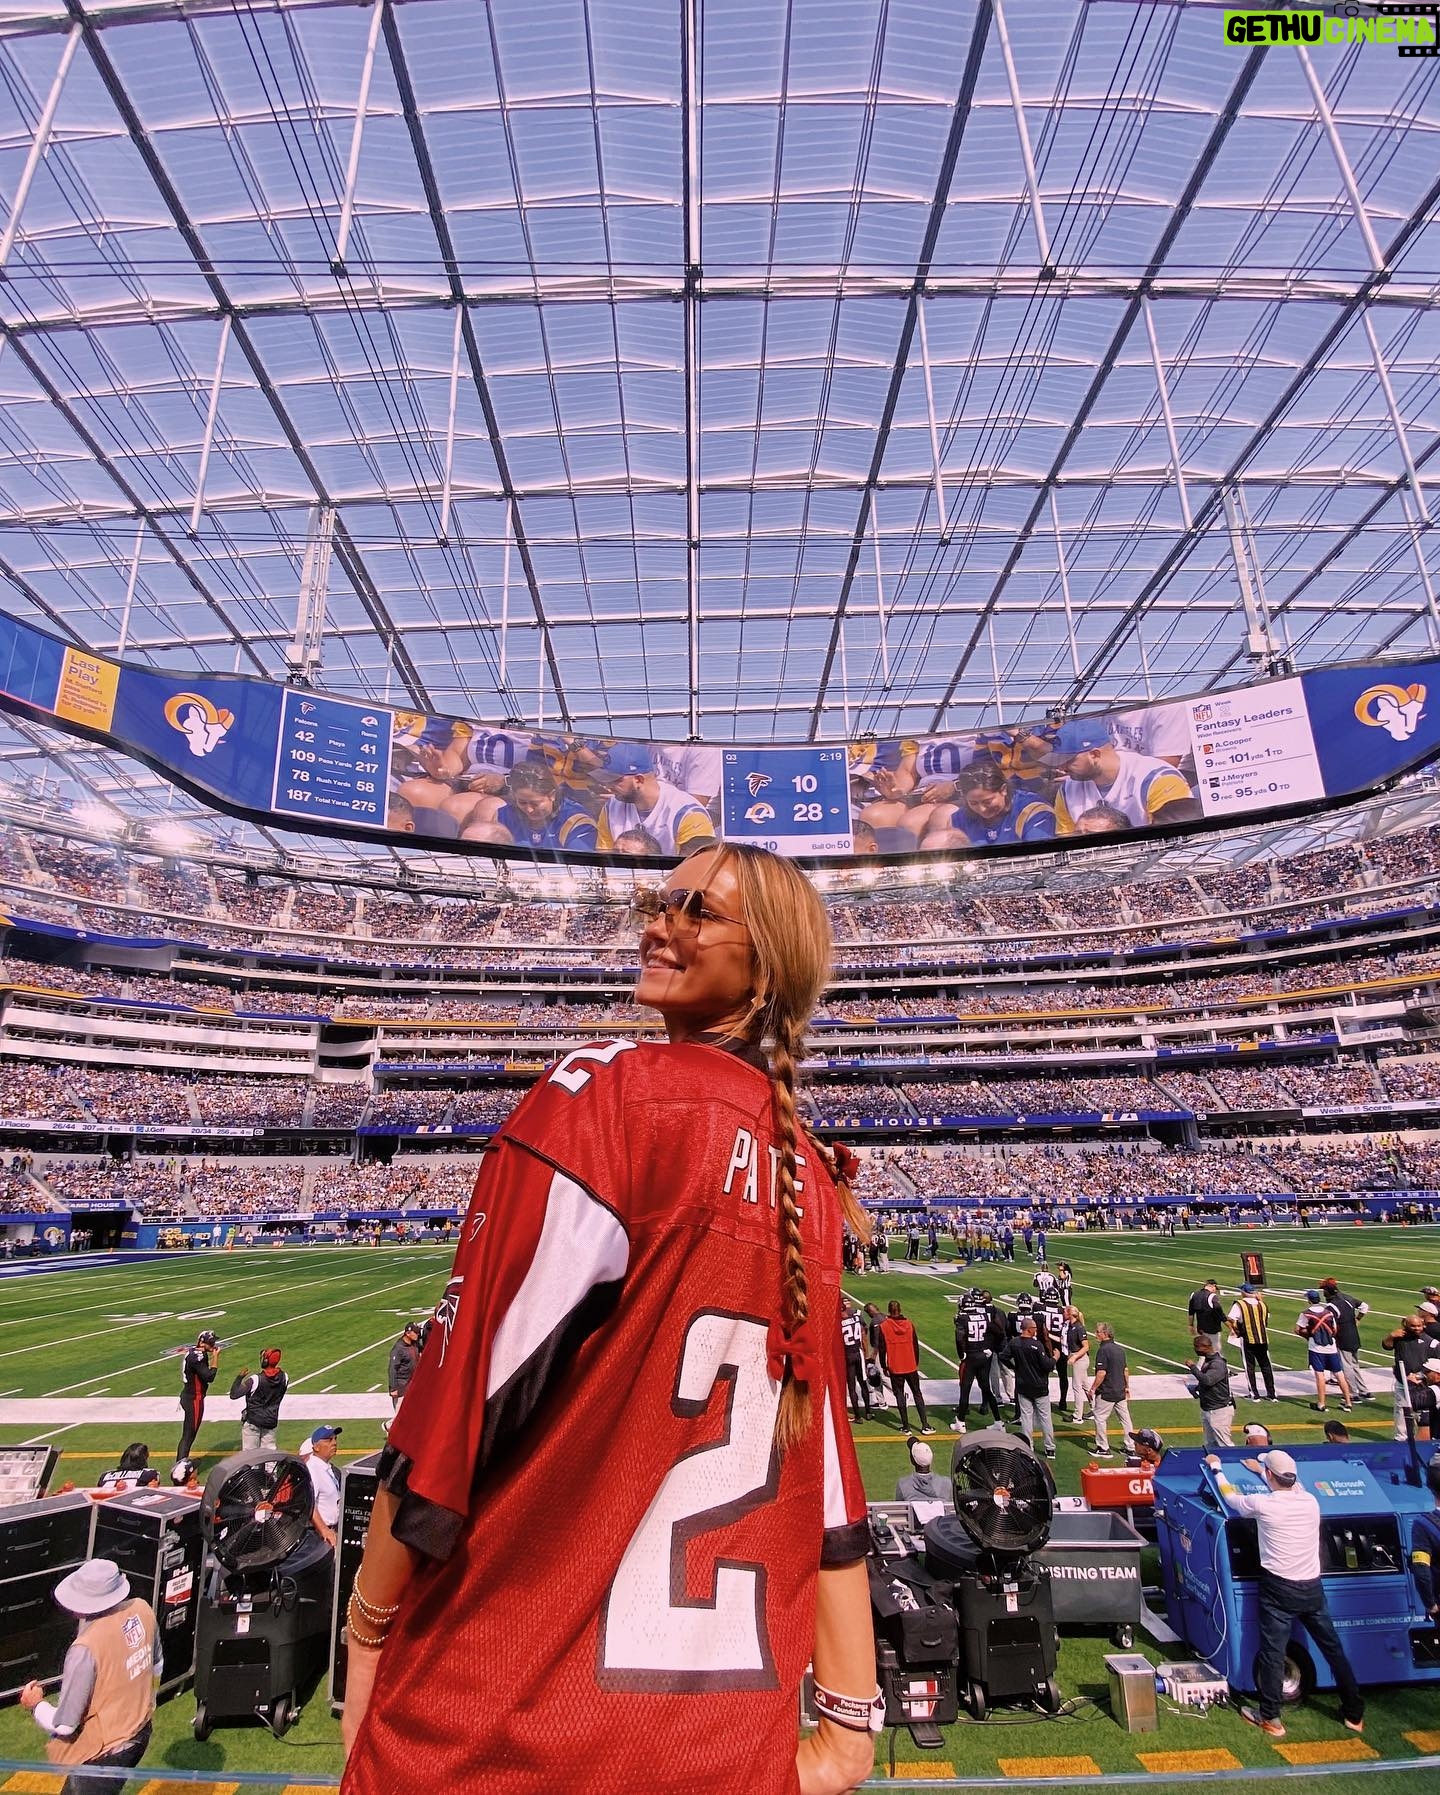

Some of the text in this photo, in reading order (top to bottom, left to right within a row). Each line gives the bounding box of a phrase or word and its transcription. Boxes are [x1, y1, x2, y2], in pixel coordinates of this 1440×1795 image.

[70, 654, 101, 673] Last
[68, 666, 98, 685] Play
[1196, 707, 1293, 732] Fantasy Leaders
[294, 730, 376, 754] 42 Plays 41
[1215, 737, 1252, 748] A.Cooper
[290, 749, 378, 774] 109 Pass Yards 217
[820, 752, 842, 762] 2:19
[1205, 759, 1214, 768] 9
[1229, 752, 1250, 763] 101
[1264, 748, 1271, 757] 1
[292, 769, 374, 793] 78 Rush Yards 58
[792, 774, 818, 793] 10
[1221, 771, 1258, 782] J.Meyers
[287, 789, 312, 802] 187
[332, 799, 350, 807] Yards
[352, 800, 376, 812] 275
[1211, 793, 1220, 802] 9
[1235, 787, 1252, 798] 95
[1268, 782, 1278, 792] 0
[793, 803, 824, 822] 28
[836, 840, 850, 849] 50
[806, 1118, 942, 1127] RAMS HOUSE
[1248, 1256, 1259, 1276] 1
[842, 1322, 862, 1346] 24
[968, 1320, 988, 1342] 92
[1128, 1480, 1154, 1495] GA
[1331, 1480, 1366, 1489] Microsoft
[1335, 1486, 1364, 1496] Surface
[597, 1306, 784, 1694] 2
[1099, 1566, 1137, 1579] TEAM
[126, 1626, 141, 1645] NFL
[833, 1704, 860, 1716] Founders
